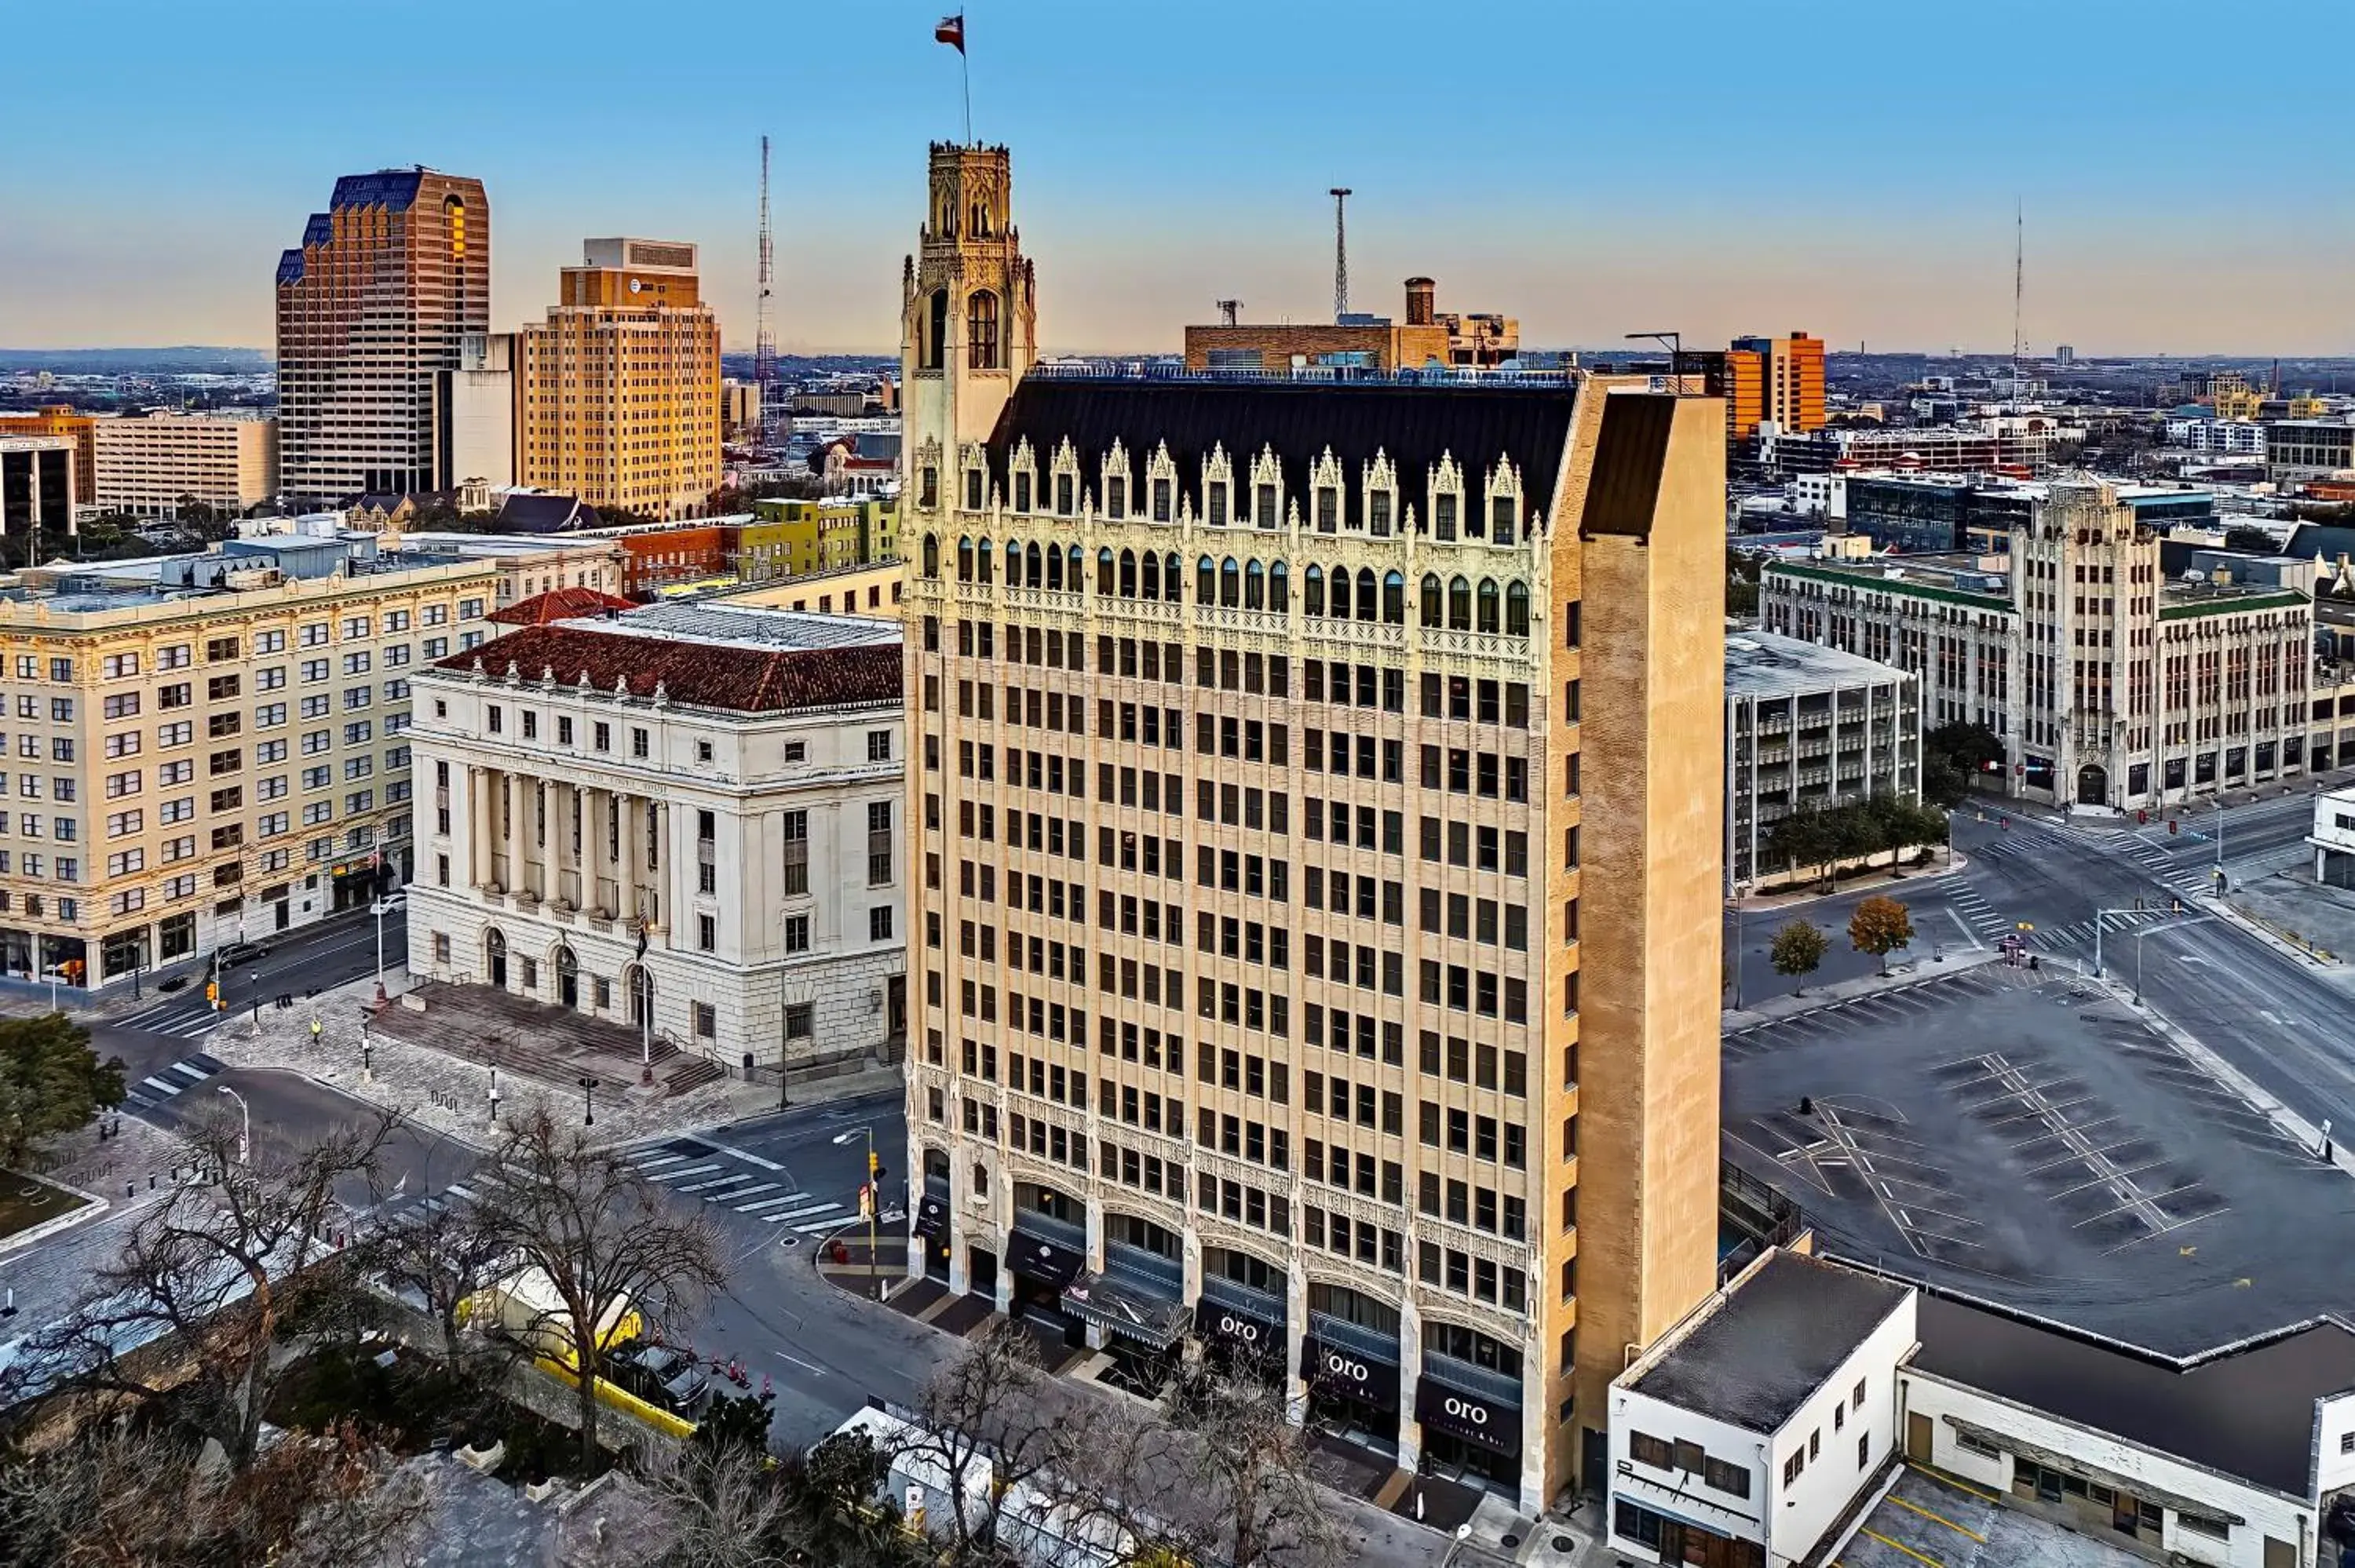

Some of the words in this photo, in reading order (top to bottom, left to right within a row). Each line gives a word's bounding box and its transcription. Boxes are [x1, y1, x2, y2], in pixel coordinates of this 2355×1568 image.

[1221, 1316, 1257, 1340] oro
[1329, 1355, 1368, 1381] oro
[1444, 1398, 1488, 1424] oro
